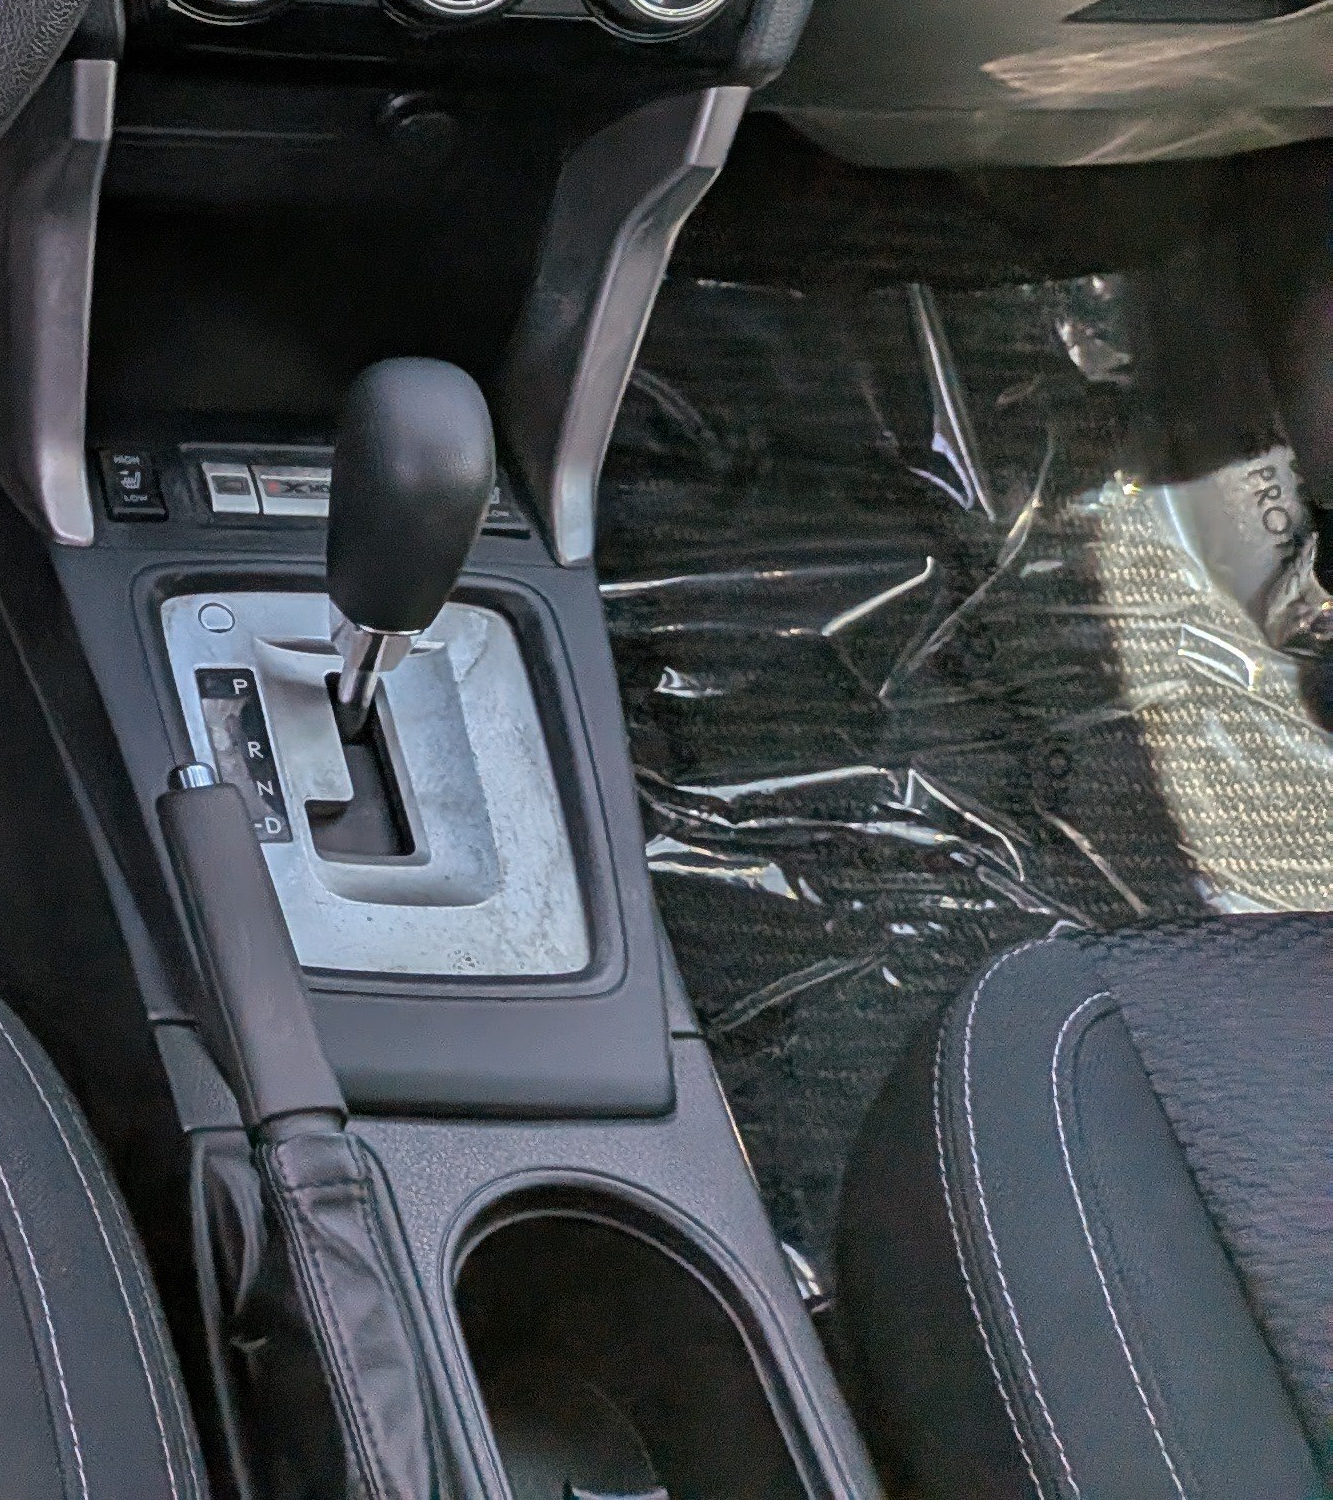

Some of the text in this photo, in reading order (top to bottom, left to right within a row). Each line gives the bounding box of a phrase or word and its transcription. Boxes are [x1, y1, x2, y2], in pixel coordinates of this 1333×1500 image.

[232, 678, 248, 695] P
[247, 741, 264, 759] R
[256, 780, 274, 796] N
